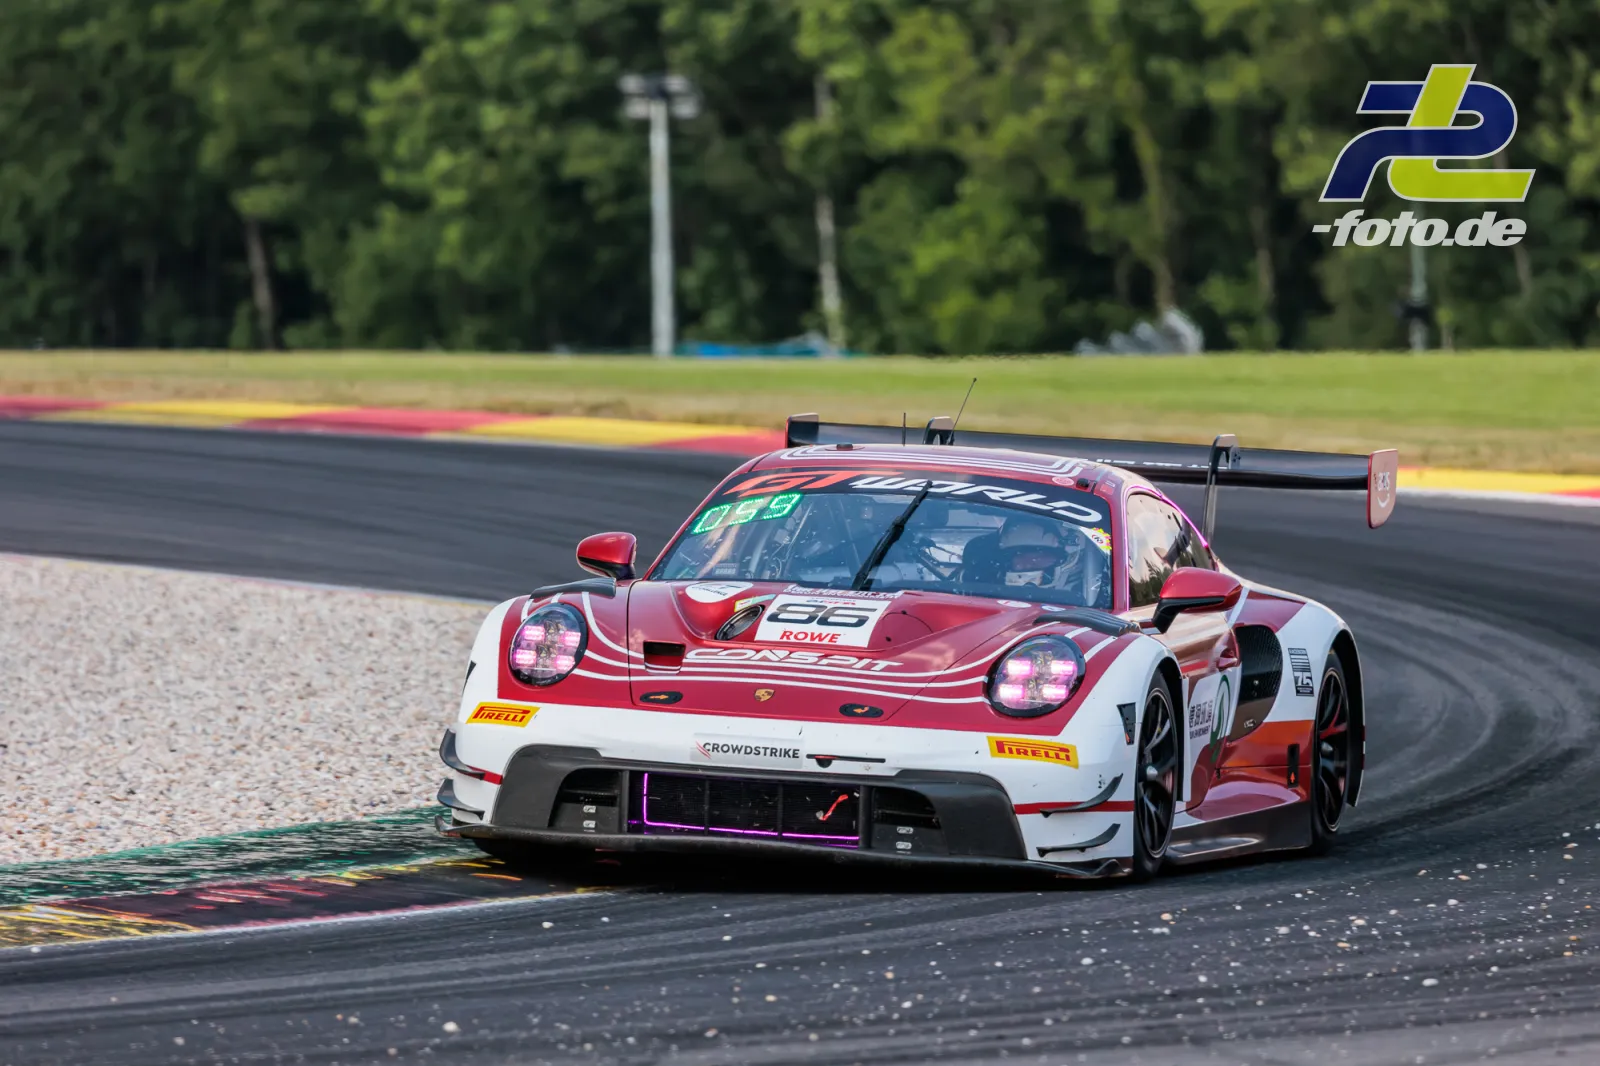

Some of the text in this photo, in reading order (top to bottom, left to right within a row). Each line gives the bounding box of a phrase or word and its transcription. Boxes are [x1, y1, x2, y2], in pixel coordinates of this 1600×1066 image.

[722, 470, 1103, 523] GT WORLD
[692, 493, 803, 535] 059
[766, 603, 878, 628] 86
[779, 630, 842, 643] ROWE
[685, 648, 904, 671] CONSPIT
[472, 705, 531, 723] PIRELLI
[702, 741, 800, 759] CROWDSTRIKE
[995, 740, 1071, 762] PIRELLI
